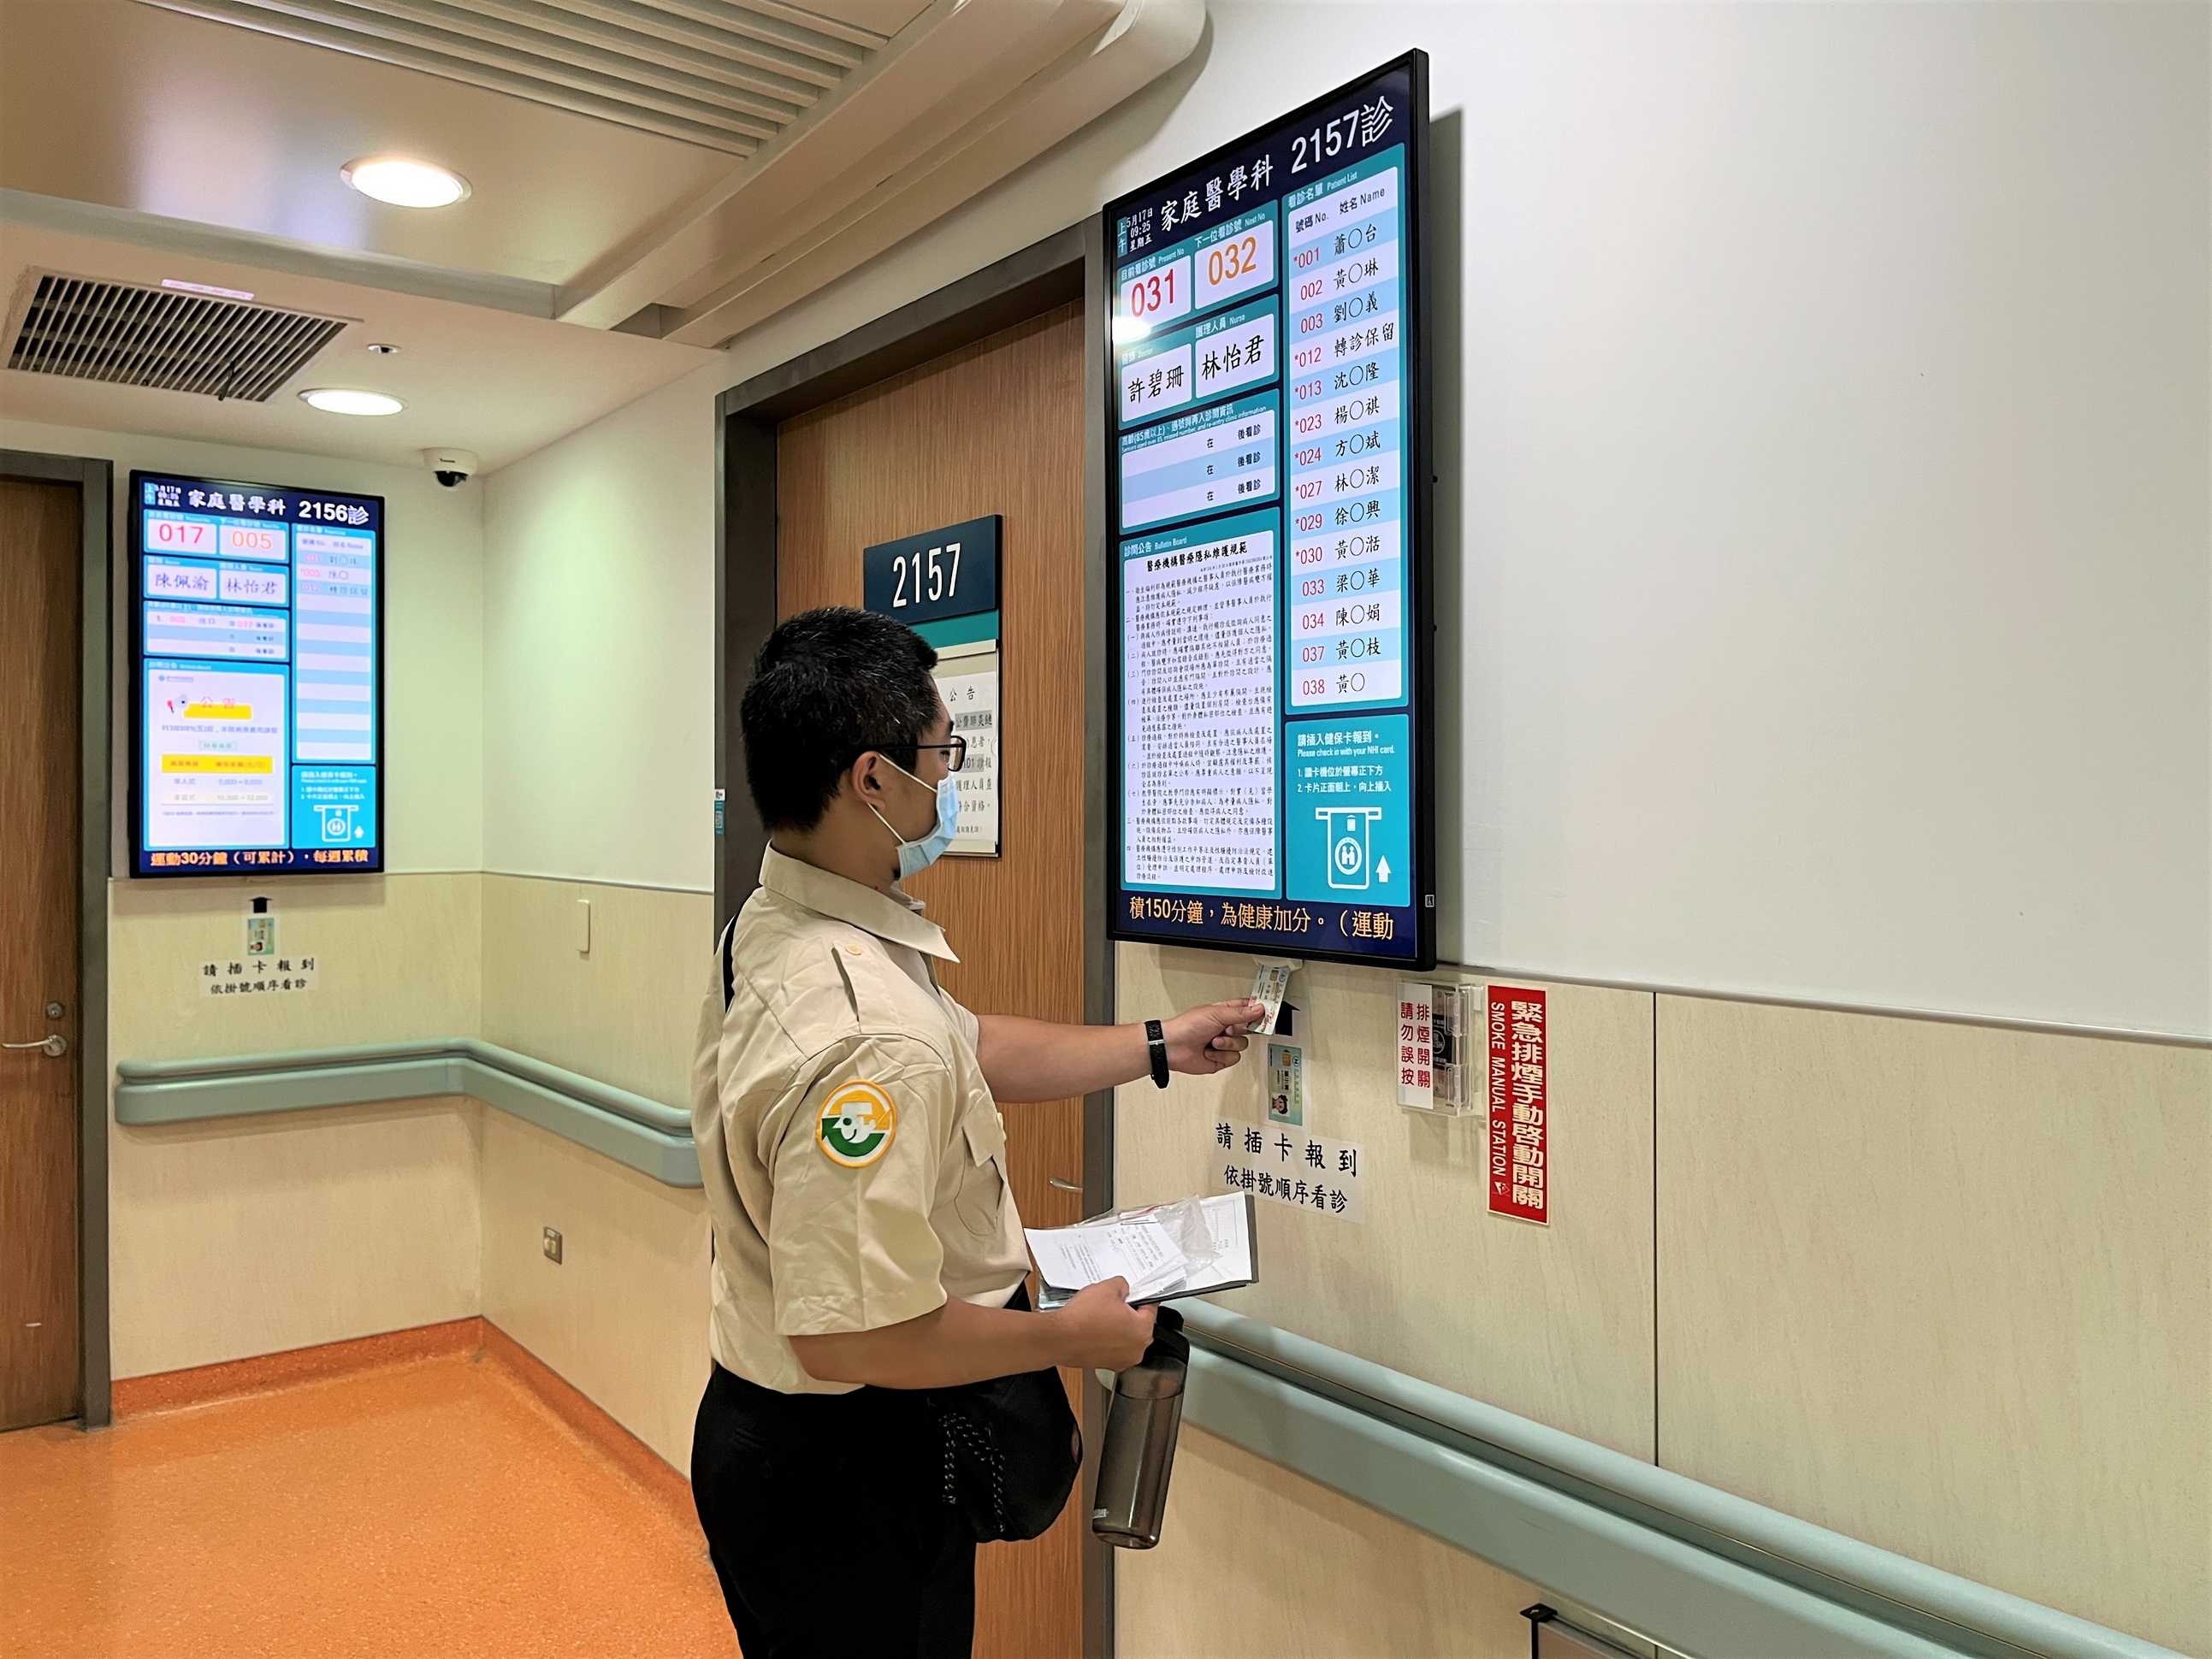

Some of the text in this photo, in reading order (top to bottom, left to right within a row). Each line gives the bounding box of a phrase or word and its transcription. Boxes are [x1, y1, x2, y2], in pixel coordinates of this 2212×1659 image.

[1160, 95, 1393, 232] 家庭醫學科 2157診
[1347, 171, 1357, 182] List
[1340, 198, 1357, 215] 姓名
[1360, 187, 1385, 205] Name
[1130, 221, 1150, 238] 09:25
[1208, 237, 1257, 286] 032
[1131, 269, 1174, 317] 031
[1300, 280, 1322, 300] 002
[1301, 313, 1323, 334] 003
[1334, 322, 1394, 357] 轉診保留
[1202, 334, 1264, 380] 林怡君
[1127, 365, 1184, 404] 許碧珊
[1206, 438, 1214, 448] 在
[1206, 464, 1214, 475] 在
[1206, 492, 1214, 501] 在
[299, 500, 370, 525] 2156診
[159, 523, 204, 543] 017
[232, 530, 272, 550] 005
[1173, 536, 1187, 546] Board
[892, 542, 961, 608] 2157
[226, 577, 278, 594] 林怡君
[1302, 579, 1325, 597] 033
[1302, 612, 1325, 630] 034
[1302, 646, 1325, 663] 037
[949, 685, 975, 702] 公告
[1303, 679, 1325, 695] 038
[1297, 748, 1316, 757] Please
[1316, 747, 1333, 757] check
[1340, 747, 1352, 755] with
[1353, 748, 1366, 757] your
[1367, 746, 1379, 754] NHI
[1379, 745, 1395, 754] card.
[1400, 1002, 1414, 1086] 請勿誤按
[1417, 1003, 1430, 1088] 排煙開關
[1491, 1001, 1506, 1176] SMOKE MANUAL STATION
[1215, 1123, 1357, 1177] 請插卡報到
[1224, 1165, 1348, 1213] 依掛號順序看診
